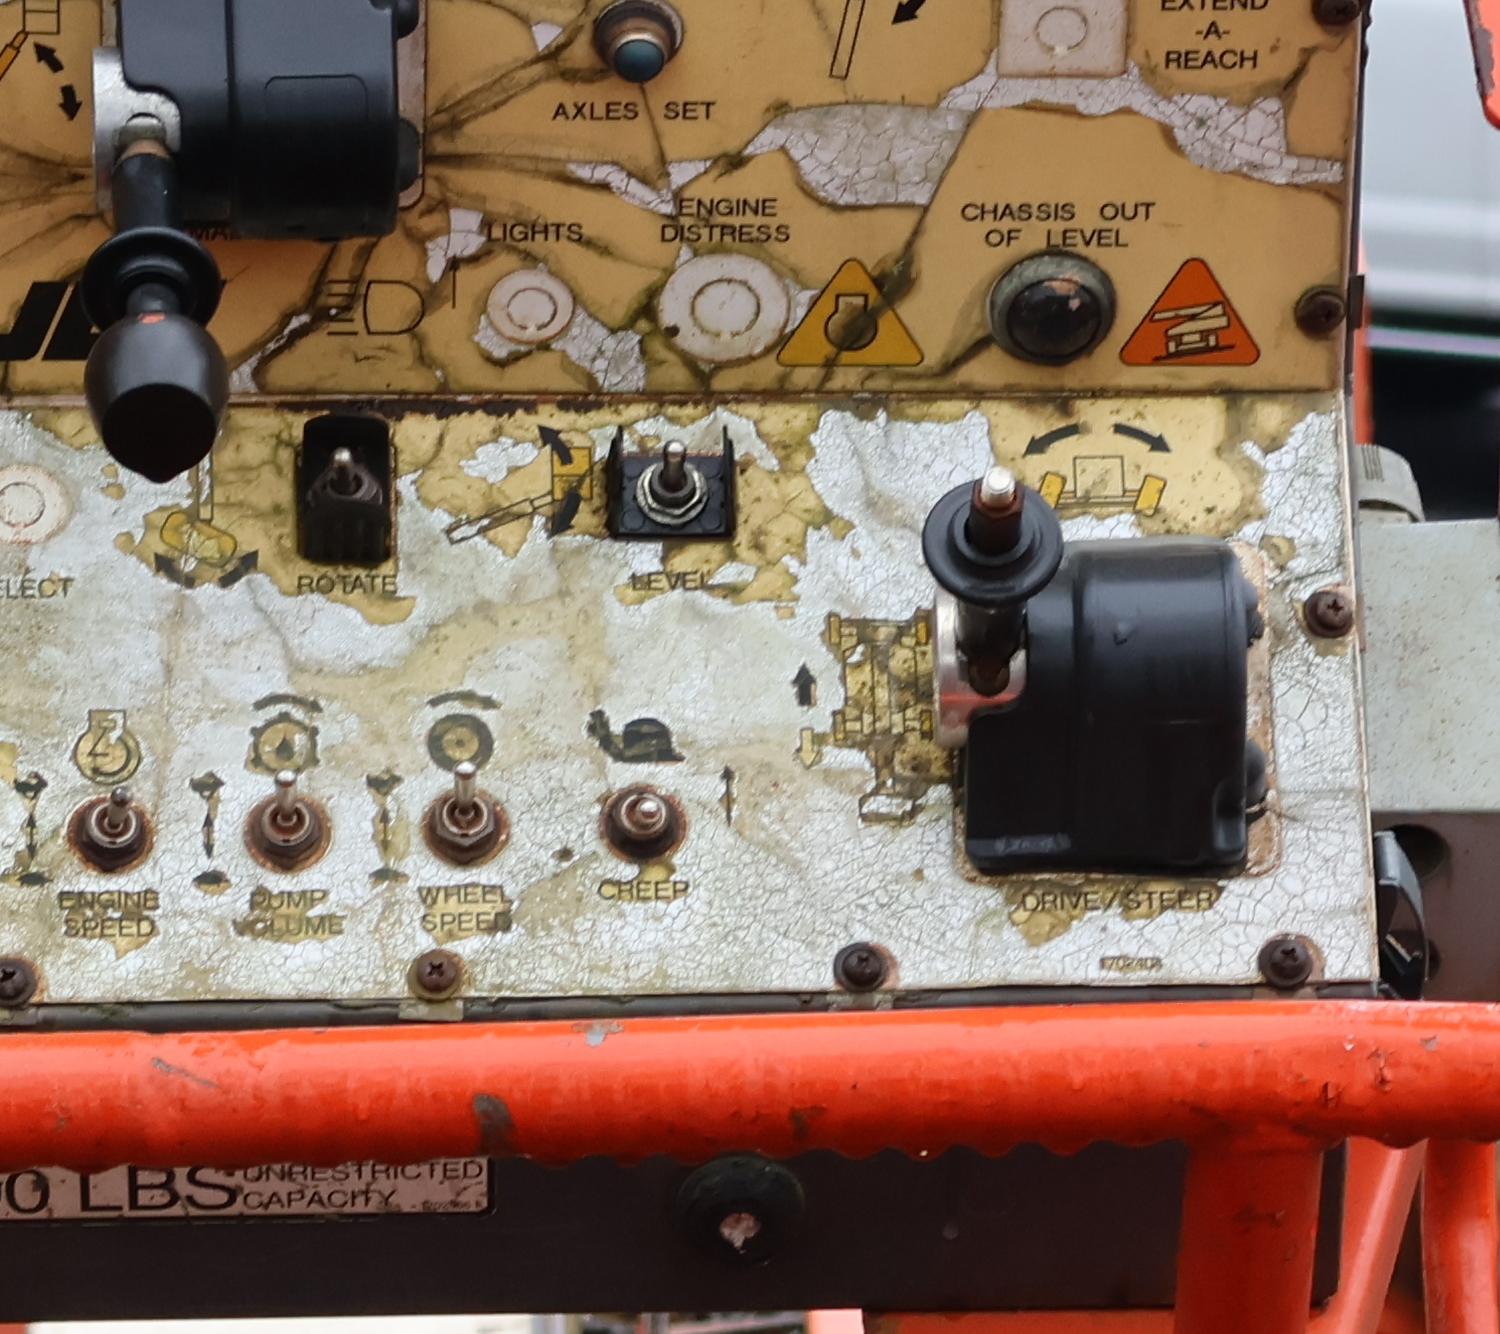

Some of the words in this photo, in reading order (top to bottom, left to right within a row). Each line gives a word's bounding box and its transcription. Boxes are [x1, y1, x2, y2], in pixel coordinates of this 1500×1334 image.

[1196, 22, 1230, 40] -A-
[1164, 49, 1259, 69] REACH
[551, 101, 639, 120] AXLES
[663, 100, 717, 120] SET
[678, 198, 778, 217] ENGINE
[960, 202, 1076, 222] CHASSIS
[1100, 202, 1157, 221] OUT
[486, 222, 584, 243] LIGHTS
[660, 223, 791, 243] DISTRESS
[985, 228, 1022, 248] OF
[1046, 227, 1129, 248] LEVEL
[297, 574, 398, 595] ROTATE
[631, 573, 710, 591] LEVEL
[59, 890, 160, 911] ENGINE
[250, 888, 327, 912] PUMP
[418, 885, 512, 905] WHEEL
[598, 880, 689, 901] CREEP
[64, 917, 157, 938] SPEED
[421, 913, 512, 933] SPEED
[242, 1160, 485, 1183] UNRESTRICTED
[79, 1164, 238, 1213] LBS
[242, 1189, 397, 1210] CAPACITY
